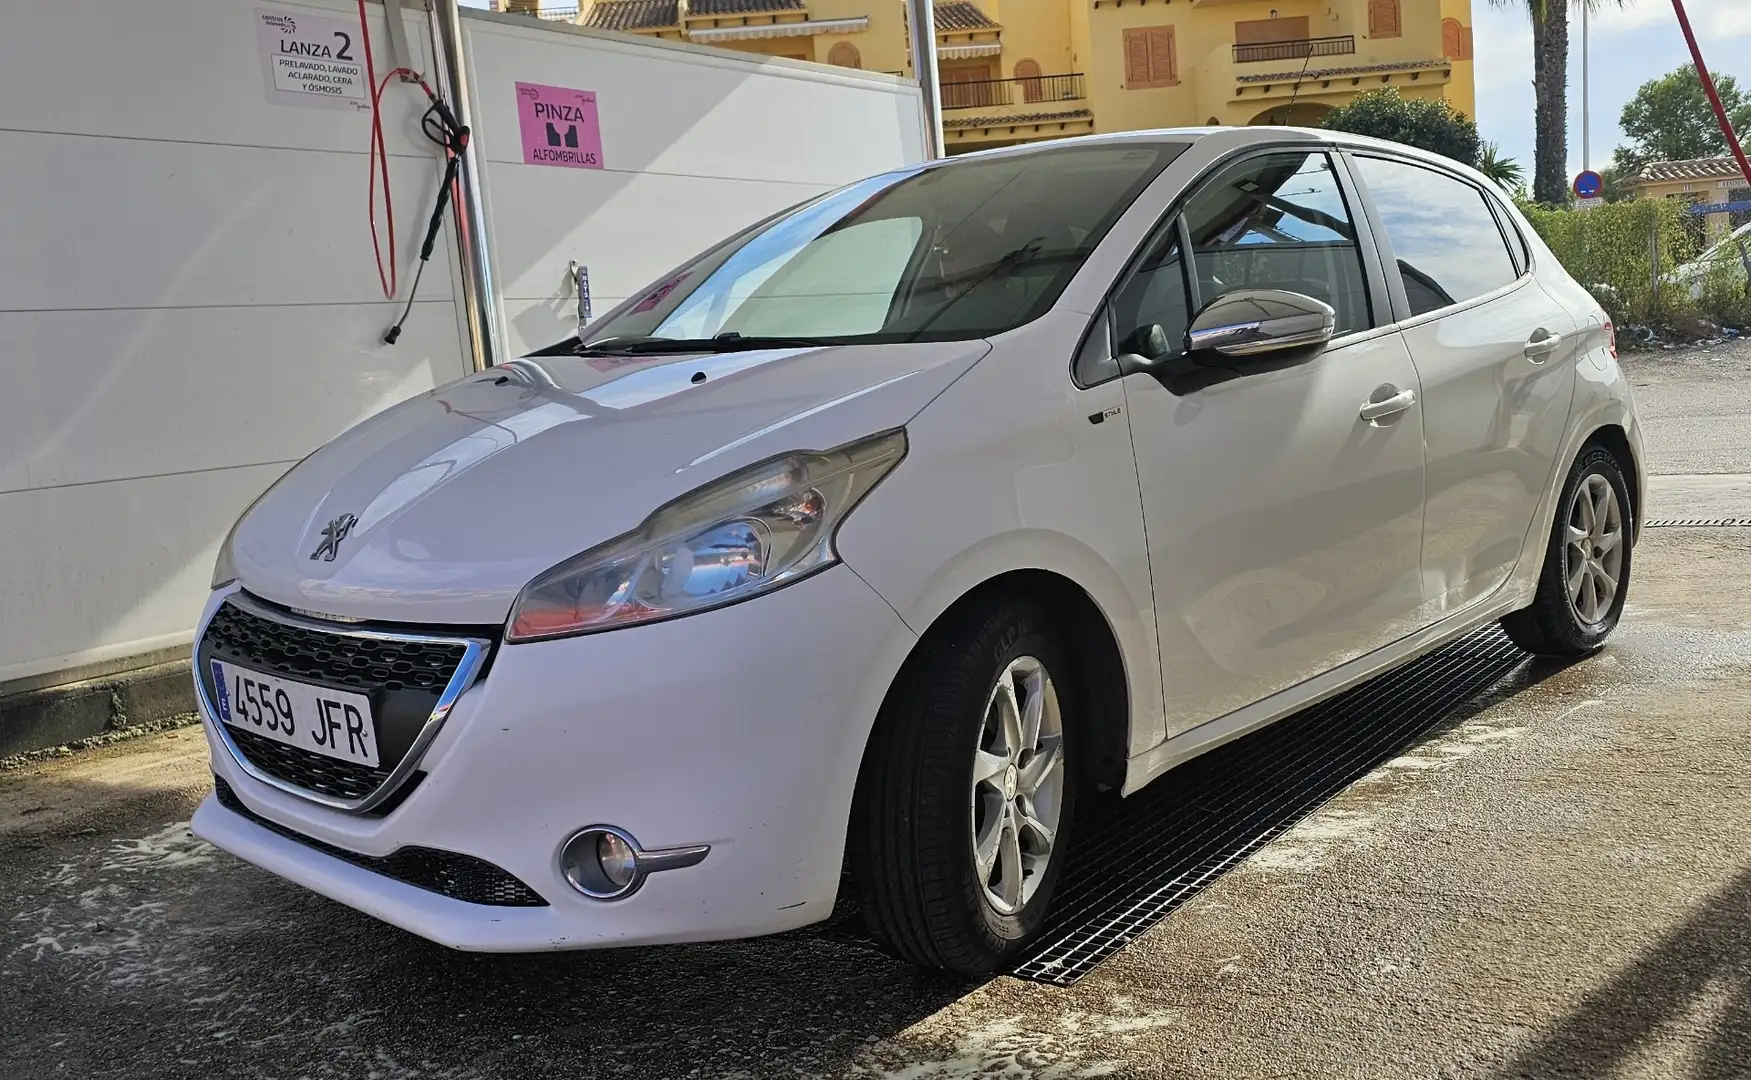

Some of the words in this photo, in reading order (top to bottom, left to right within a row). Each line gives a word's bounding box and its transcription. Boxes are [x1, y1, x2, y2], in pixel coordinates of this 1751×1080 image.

[280, 40, 331, 58] LANZA
[334, 32, 353, 61] 2
[280, 60, 327, 73] PRELAVADO,
[328, 65, 358, 75] LAVADO
[288, 72, 332, 84] ACLARADO,
[333, 77, 353, 85] CERA
[308, 83, 342, 95] ÓSMOSIS
[534, 102, 585, 123] PINZA
[533, 149, 596, 165] ALFOMBRILLAS
[1104, 407, 1121, 418] STYLE
[221, 698, 228, 711] E
[235, 675, 295, 736] 4559
[311, 698, 368, 757] JFR
